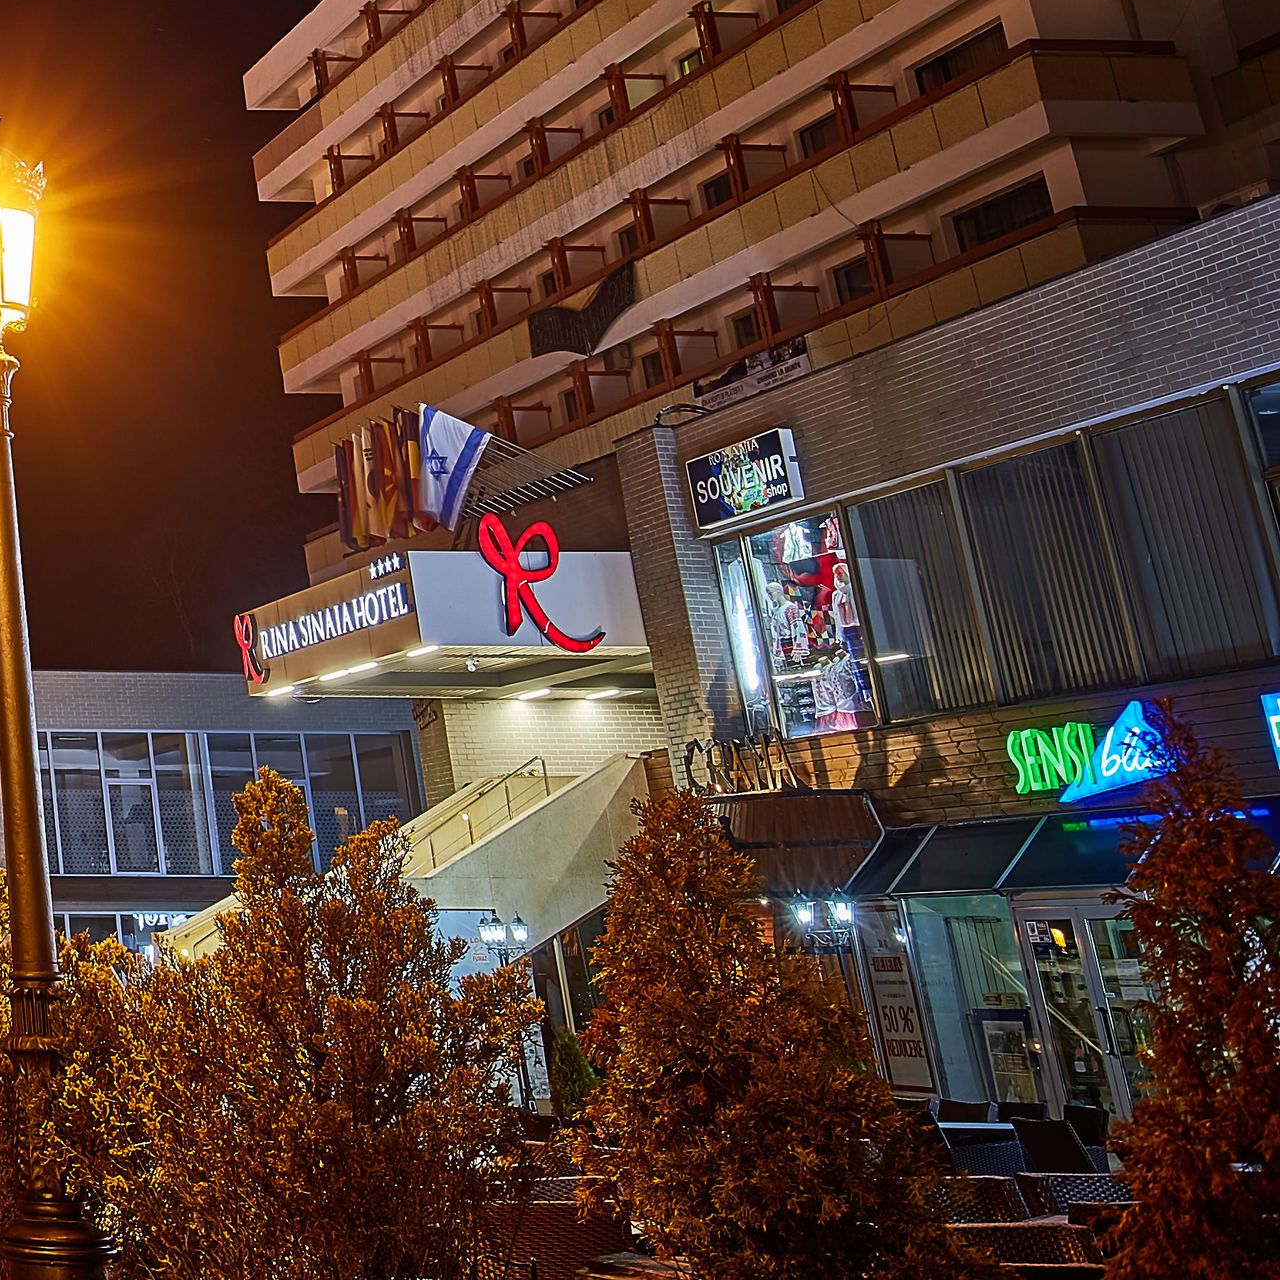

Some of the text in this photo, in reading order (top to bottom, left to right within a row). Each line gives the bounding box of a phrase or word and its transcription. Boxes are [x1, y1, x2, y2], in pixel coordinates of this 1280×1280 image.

[696, 454, 786, 505] SOUVENIR
[766, 482, 789, 499] shop
[260, 627, 299, 661] RINA
[298, 603, 354, 646] SINAIA
[353, 581, 409, 631] HOTEL
[1006, 721, 1097, 795] SENSI
[886, 1038, 925, 1058] REDUCERE
